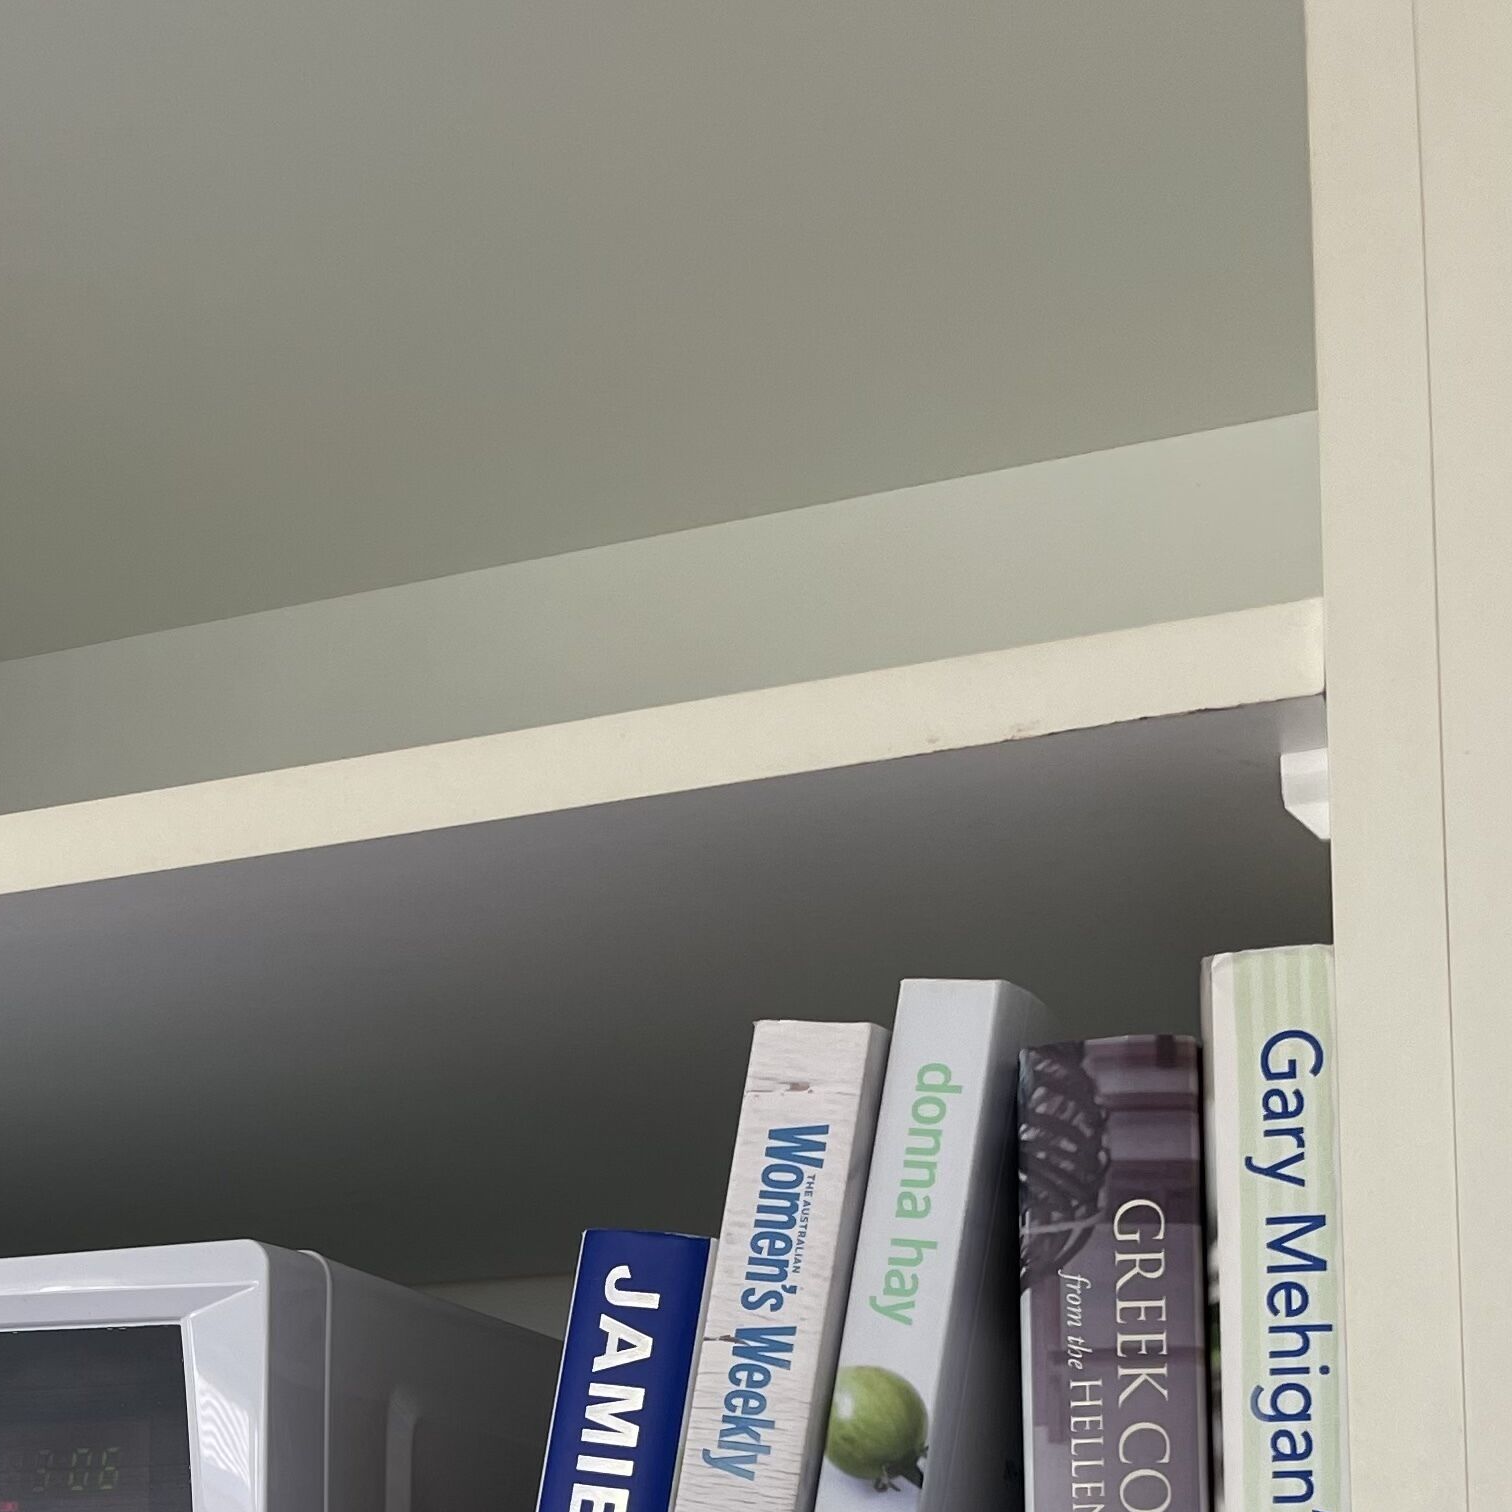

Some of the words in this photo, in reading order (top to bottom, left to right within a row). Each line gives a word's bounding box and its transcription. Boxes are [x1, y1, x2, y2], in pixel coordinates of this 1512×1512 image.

[895, 1061, 963, 1219] donna
[1245, 1028, 1325, 1188] Gary
[740, 1124, 831, 1313] Women's
[791, 1198, 811, 1275] AUSTRALIAN
[803, 1172, 817, 1198] THE
[868, 1237, 939, 1327] hay
[1057, 1268, 1092, 1328] from
[1112, 1198, 1169, 1406] GREEK
[701, 1325, 798, 1482] Weekly
[1067, 1335, 1093, 1370] the
